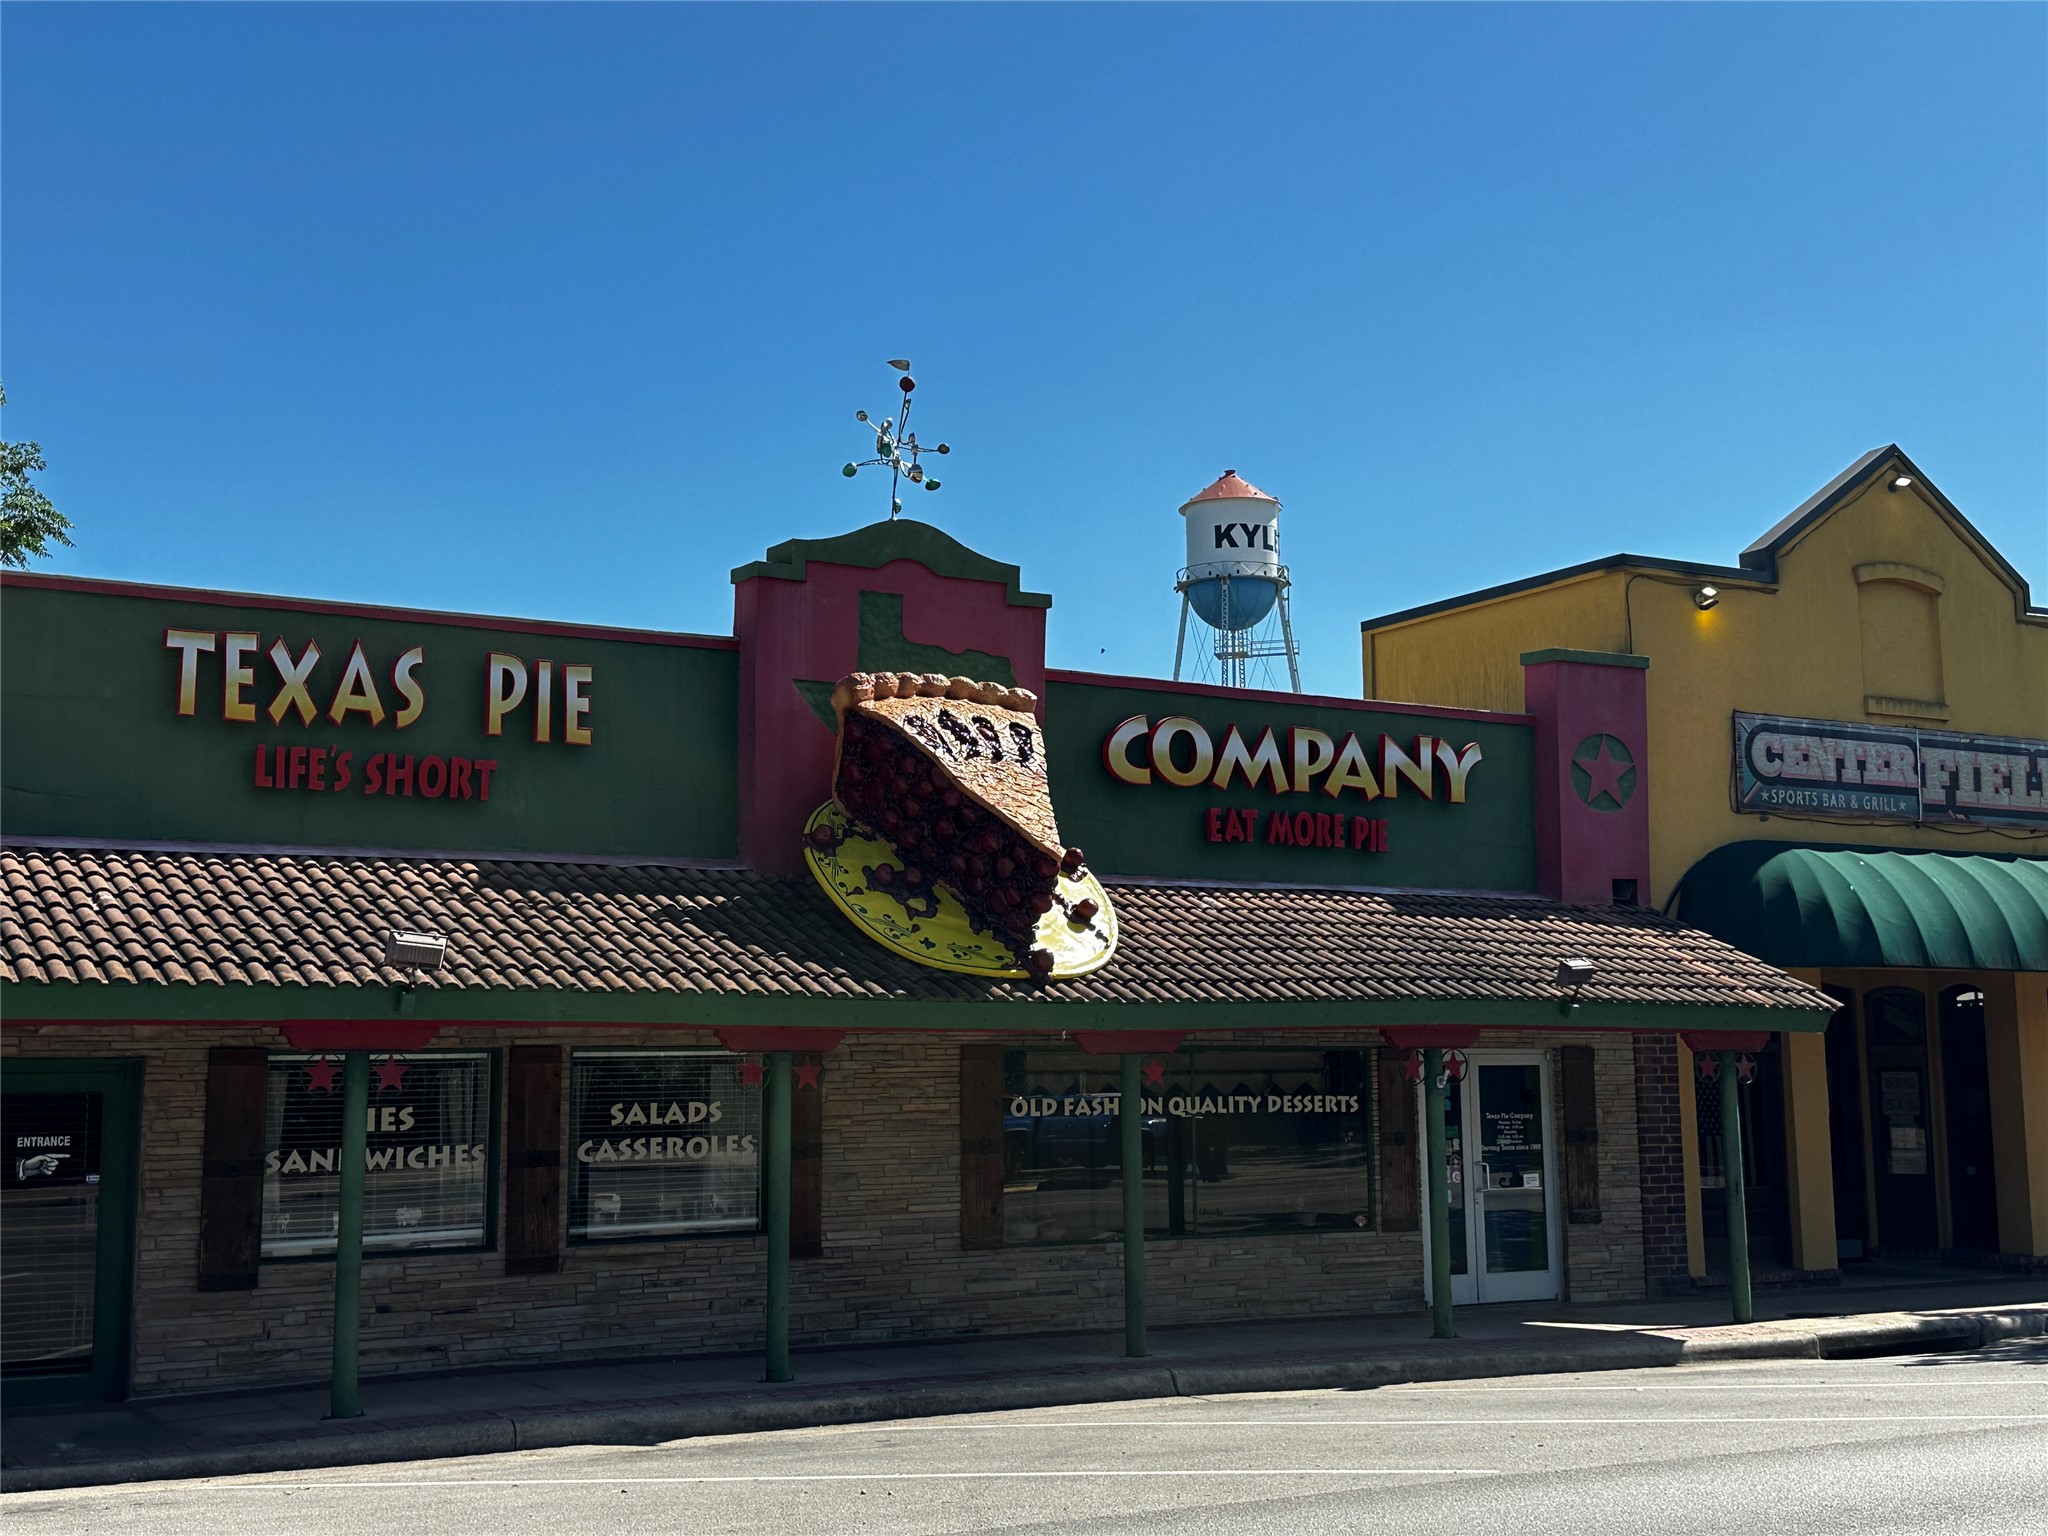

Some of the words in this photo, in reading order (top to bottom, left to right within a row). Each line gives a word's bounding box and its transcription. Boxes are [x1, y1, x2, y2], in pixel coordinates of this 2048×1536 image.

[1214, 523, 1278, 553] KYL
[163, 628, 424, 728] TEXAS
[484, 650, 594, 745] PIE
[255, 744, 353, 792] LIFE'S
[365, 752, 497, 801] SHORT
[1103, 714, 1482, 803] COMPANY
[1751, 731, 1919, 788] CENTER
[1771, 789, 1818, 806] SPORTS
[1822, 793, 1846, 808] BAR
[1850, 795, 1859, 808] &
[1863, 796, 1897, 811] GRILL
[1206, 807, 1258, 842] EAT
[1267, 810, 1345, 848] MORE
[1351, 815, 1390, 853] PIE
[366, 1106, 415, 1132] IES
[610, 1101, 722, 1126] SALADS
[1010, 1097, 1057, 1118] OLD
[1064, 1096, 1163, 1117] FASHN
[1168, 1095, 1262, 1118] QUALITY
[1268, 1095, 1359, 1113] DESSERTS
[17, 1135, 71, 1148] ENTRANCE
[577, 1134, 756, 1163] CASSEROLES
[265, 1144, 485, 1175] SANWICHES
